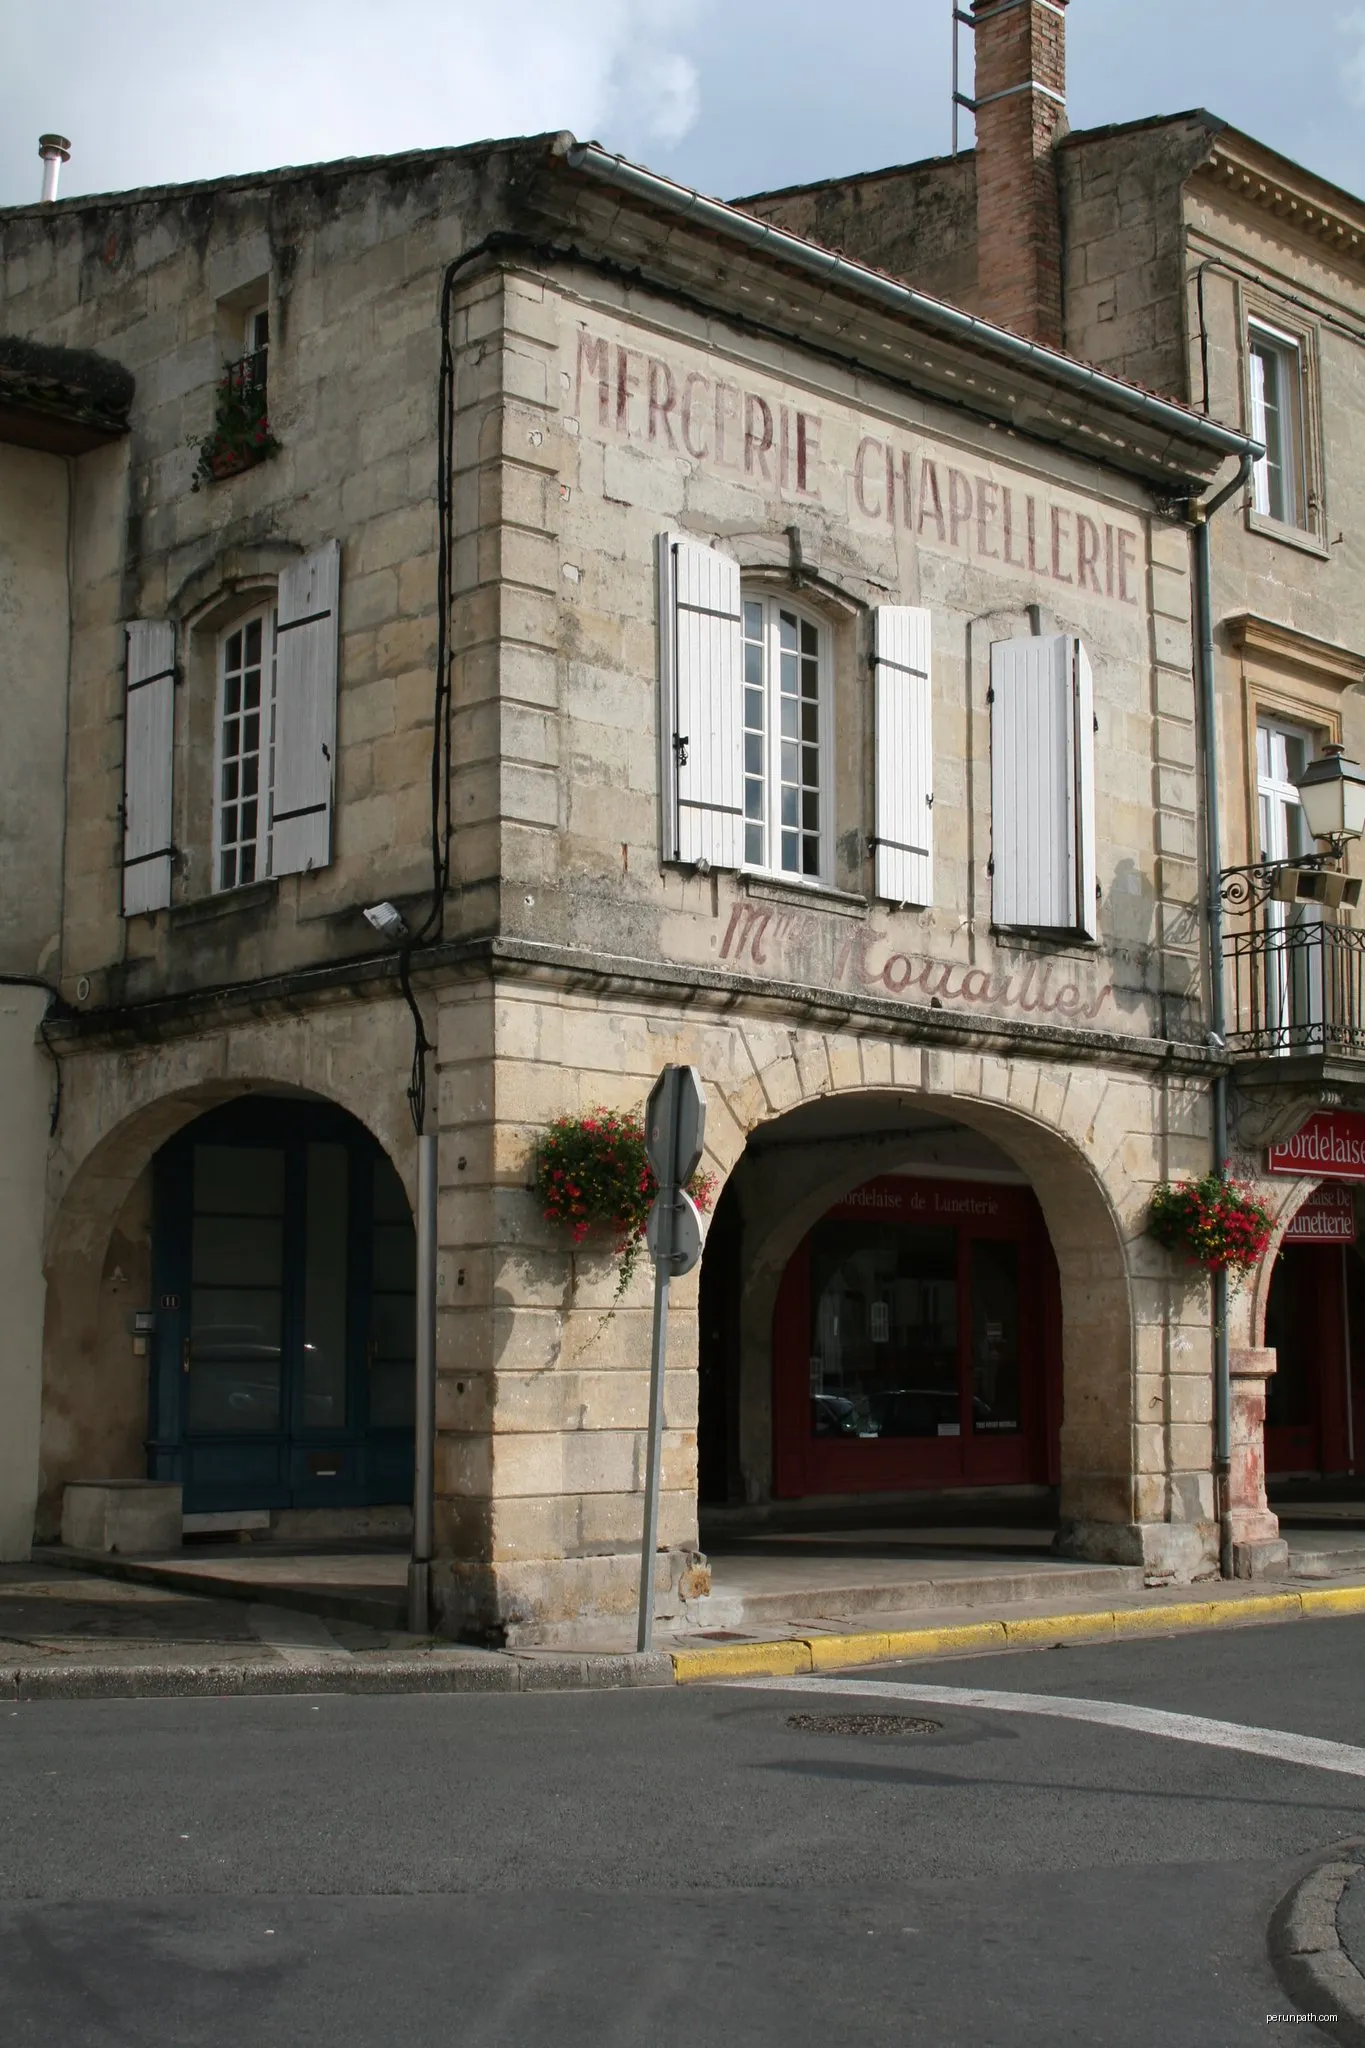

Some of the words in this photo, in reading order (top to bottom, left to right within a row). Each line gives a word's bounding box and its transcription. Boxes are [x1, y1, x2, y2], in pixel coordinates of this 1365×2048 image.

[573, 329, 824, 499] MERCERIE
[852, 435, 1139, 603] CHAPELLERIE
[841, 1187, 902, 1209] ordelaise
[910, 1191, 926, 1210] de
[934, 1192, 998, 1216] Lunetterie
[165, 1296, 175, 1307] 11
